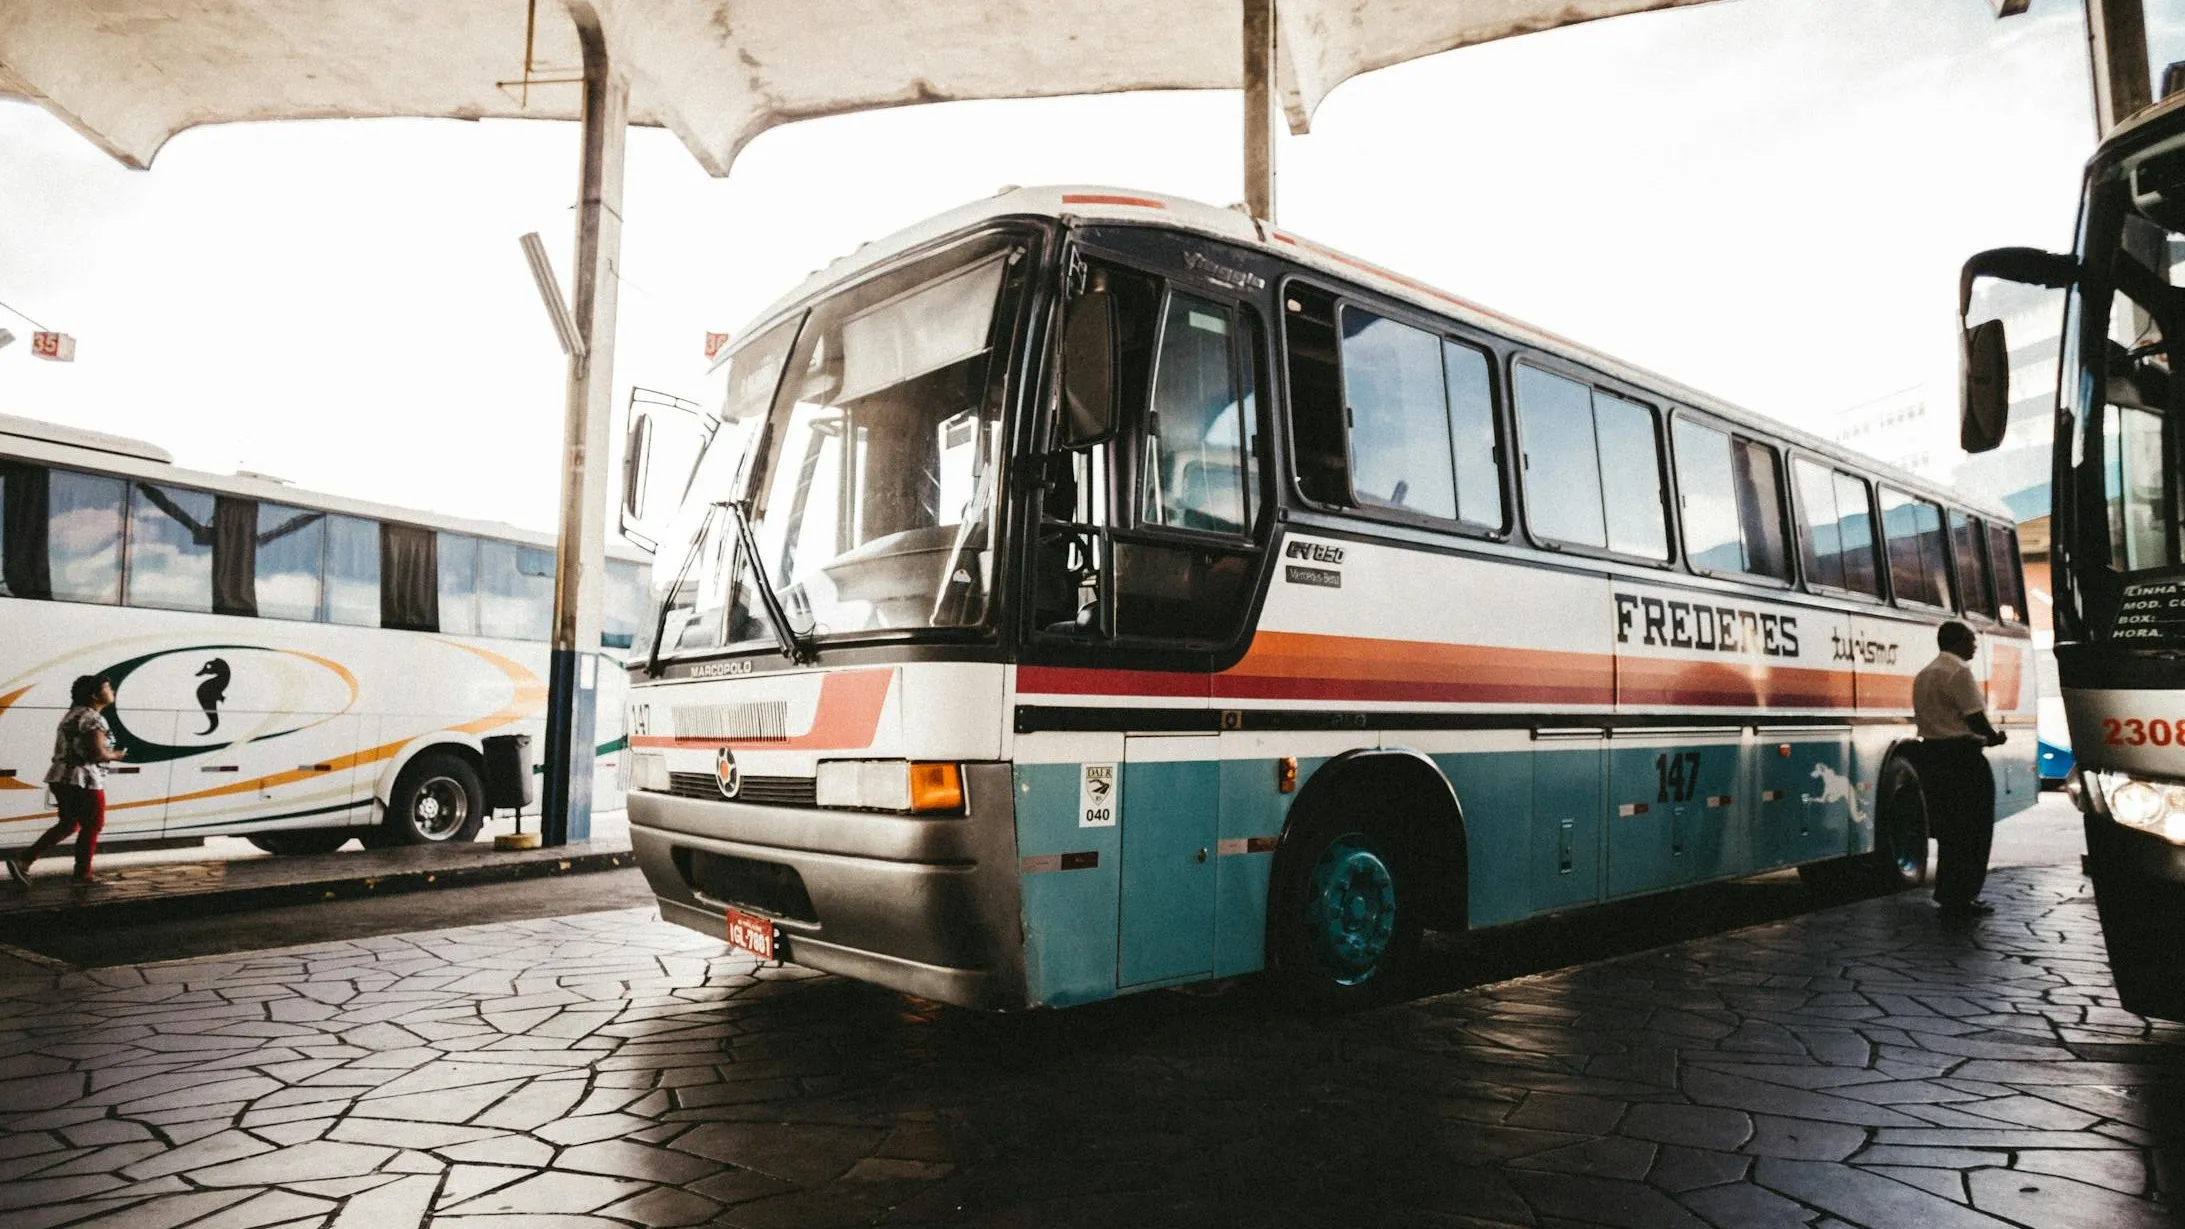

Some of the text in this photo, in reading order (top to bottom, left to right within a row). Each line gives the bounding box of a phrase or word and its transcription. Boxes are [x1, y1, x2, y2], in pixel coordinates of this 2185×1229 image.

[33, 334, 58, 353] 35
[2126, 585, 2177, 597] LINHA
[2122, 600, 2163, 611] MOD.
[2117, 614, 2156, 625] BOX:
[690, 660, 753, 678] MARCOPOLO
[1655, 751, 1701, 805] 147
[1086, 808, 1110, 822] 040
